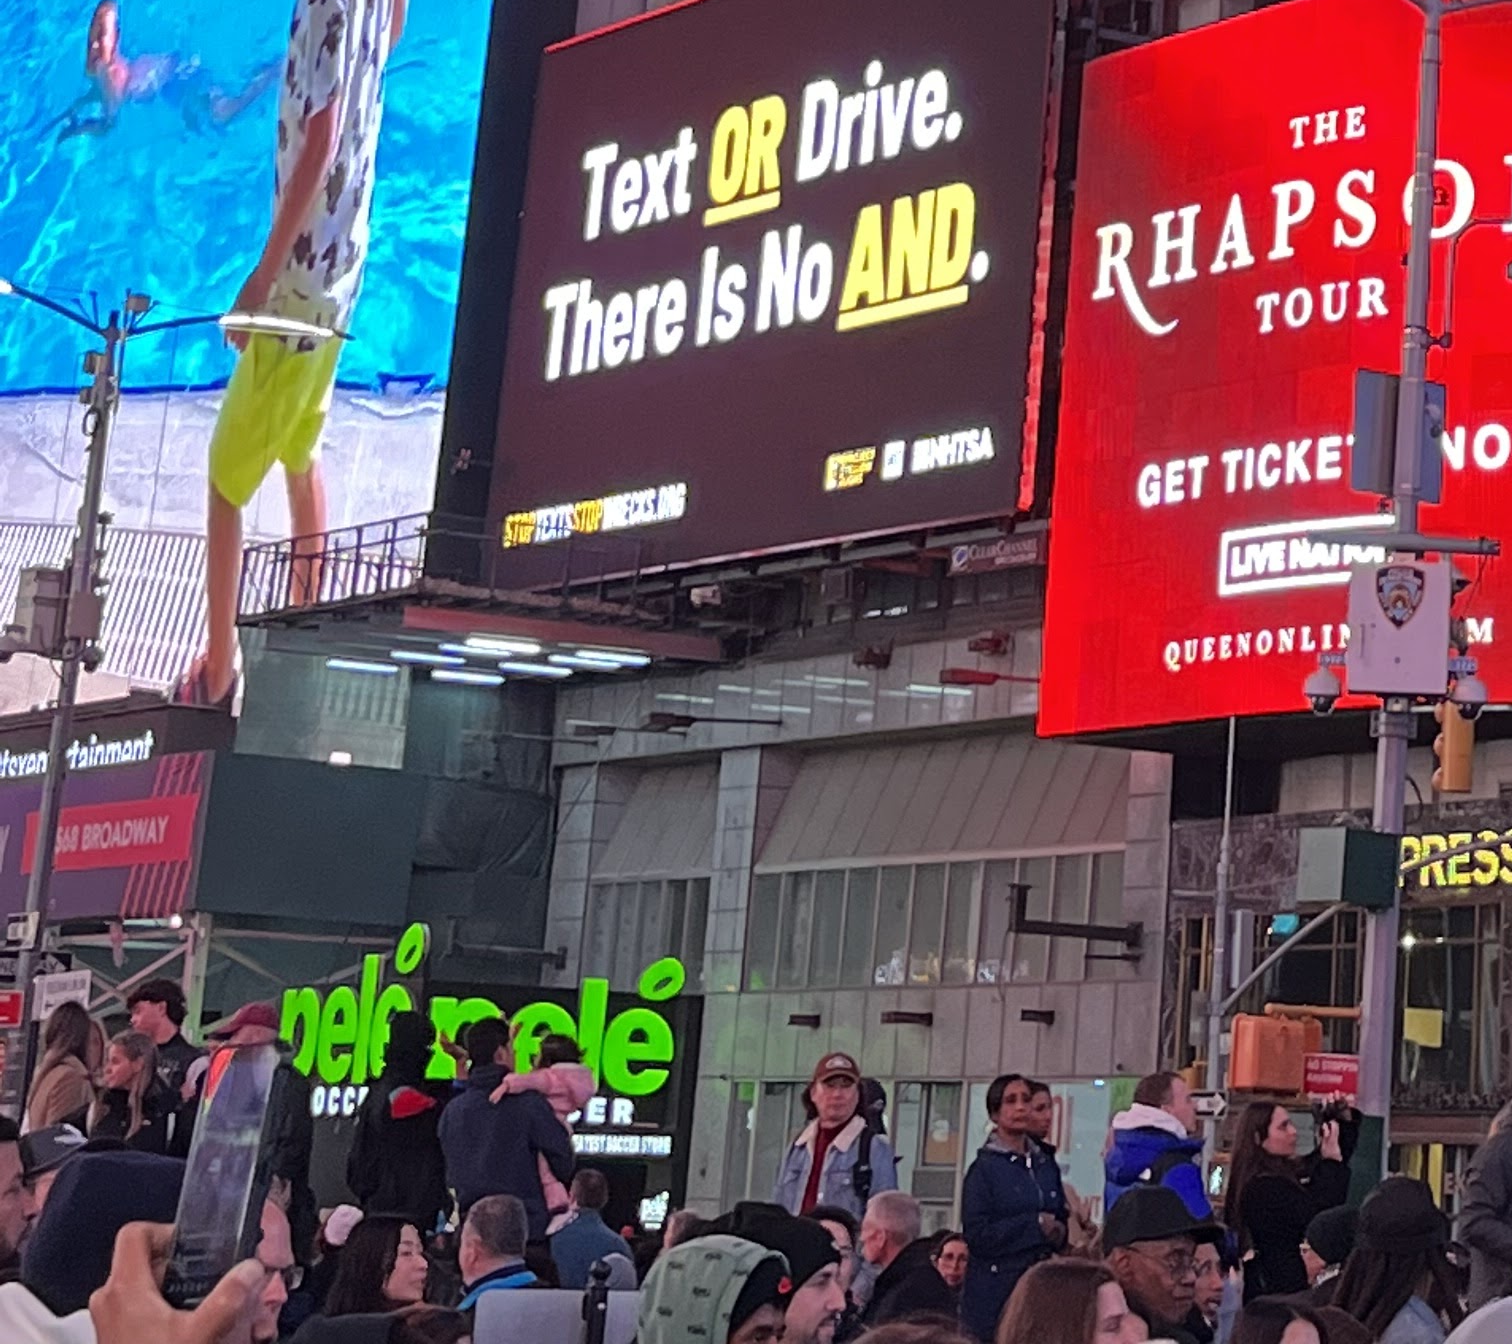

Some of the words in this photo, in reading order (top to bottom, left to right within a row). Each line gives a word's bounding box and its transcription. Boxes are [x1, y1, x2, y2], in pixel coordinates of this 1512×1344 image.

[582, 126, 698, 242] Text
[706, 94, 788, 205] OR
[796, 59, 963, 183] Drive.
[1288, 105, 1369, 150] THE
[543, 276, 687, 382] There
[694, 245, 748, 348] Is
[755, 223, 833, 333] No
[838, 180, 990, 313] AND.
[1254, 275, 1391, 335] TOUR
[1137, 454, 1210, 510] GET
[1221, 433, 1356, 494] TICKE
[81, 815, 169, 852] BROADWAY
